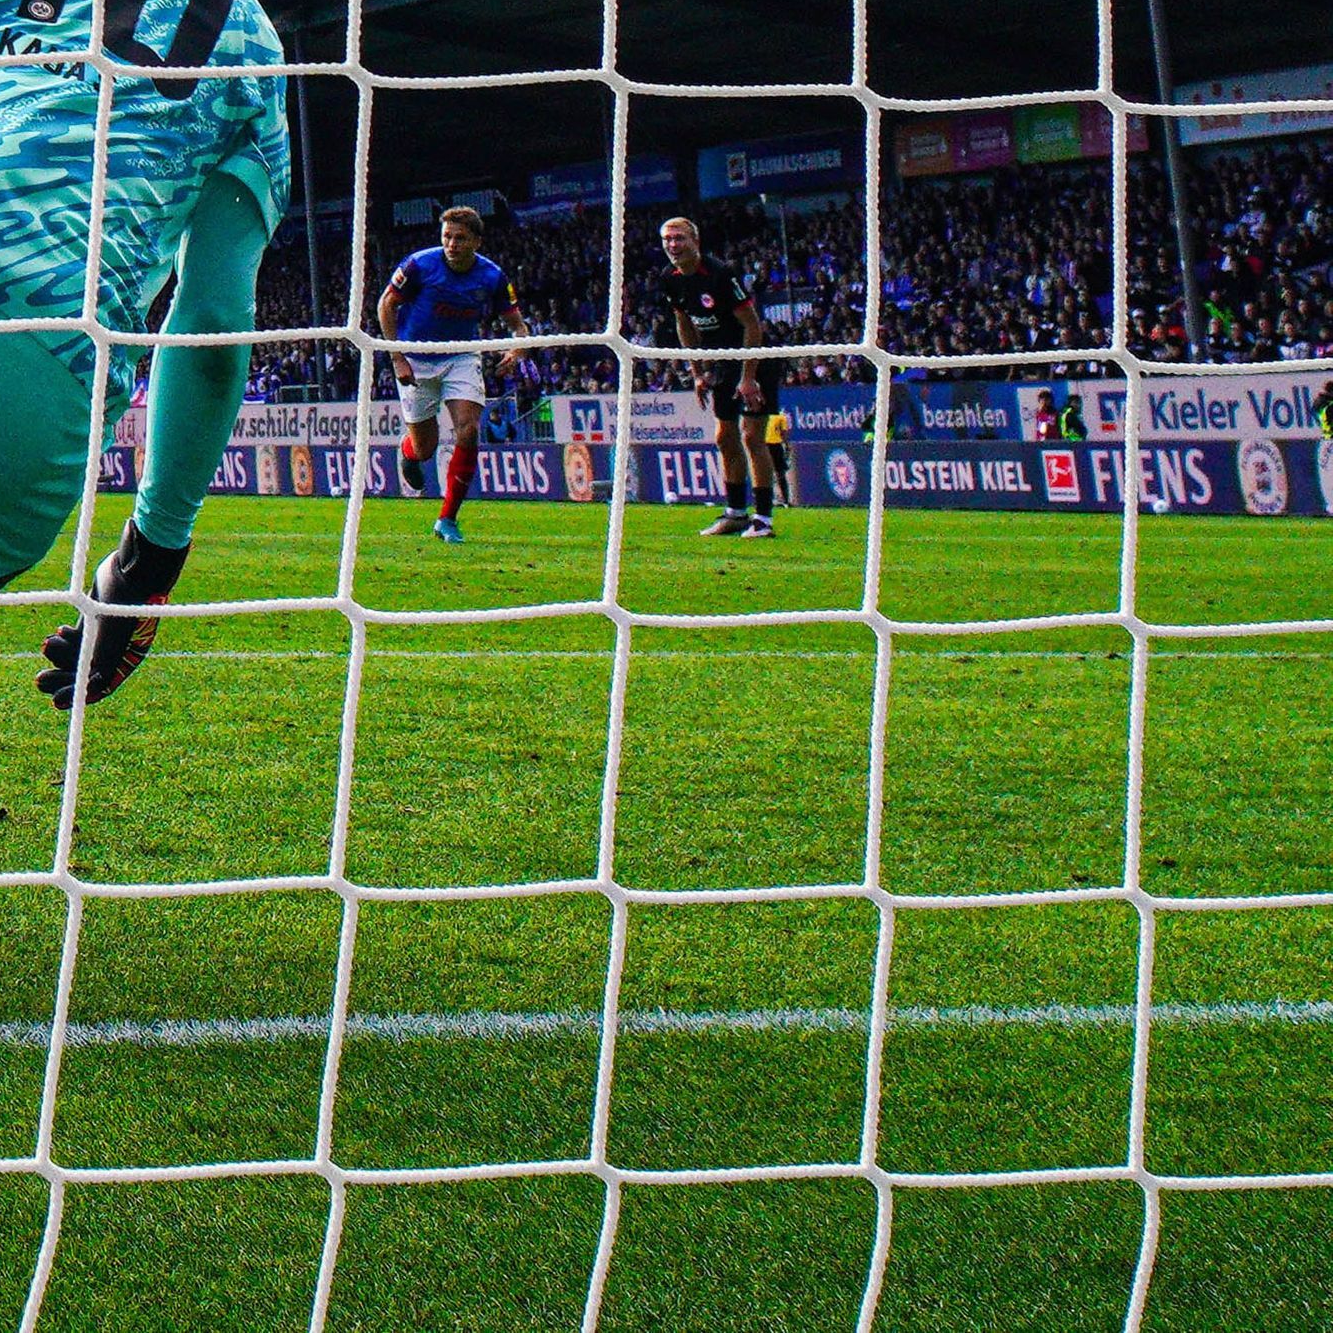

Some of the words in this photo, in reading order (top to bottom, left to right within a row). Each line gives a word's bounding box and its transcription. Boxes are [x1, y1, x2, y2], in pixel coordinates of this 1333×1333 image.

[922, 402, 1007, 429] bezahlen
[1148, 389, 1240, 431] Kieler
[1247, 385, 1321, 429] Volk
[478, 452, 550, 494] FLENS
[658, 450, 728, 498] FLEN
[884, 460, 975, 491] OLSTEIN
[981, 461, 1032, 492] KIEL
